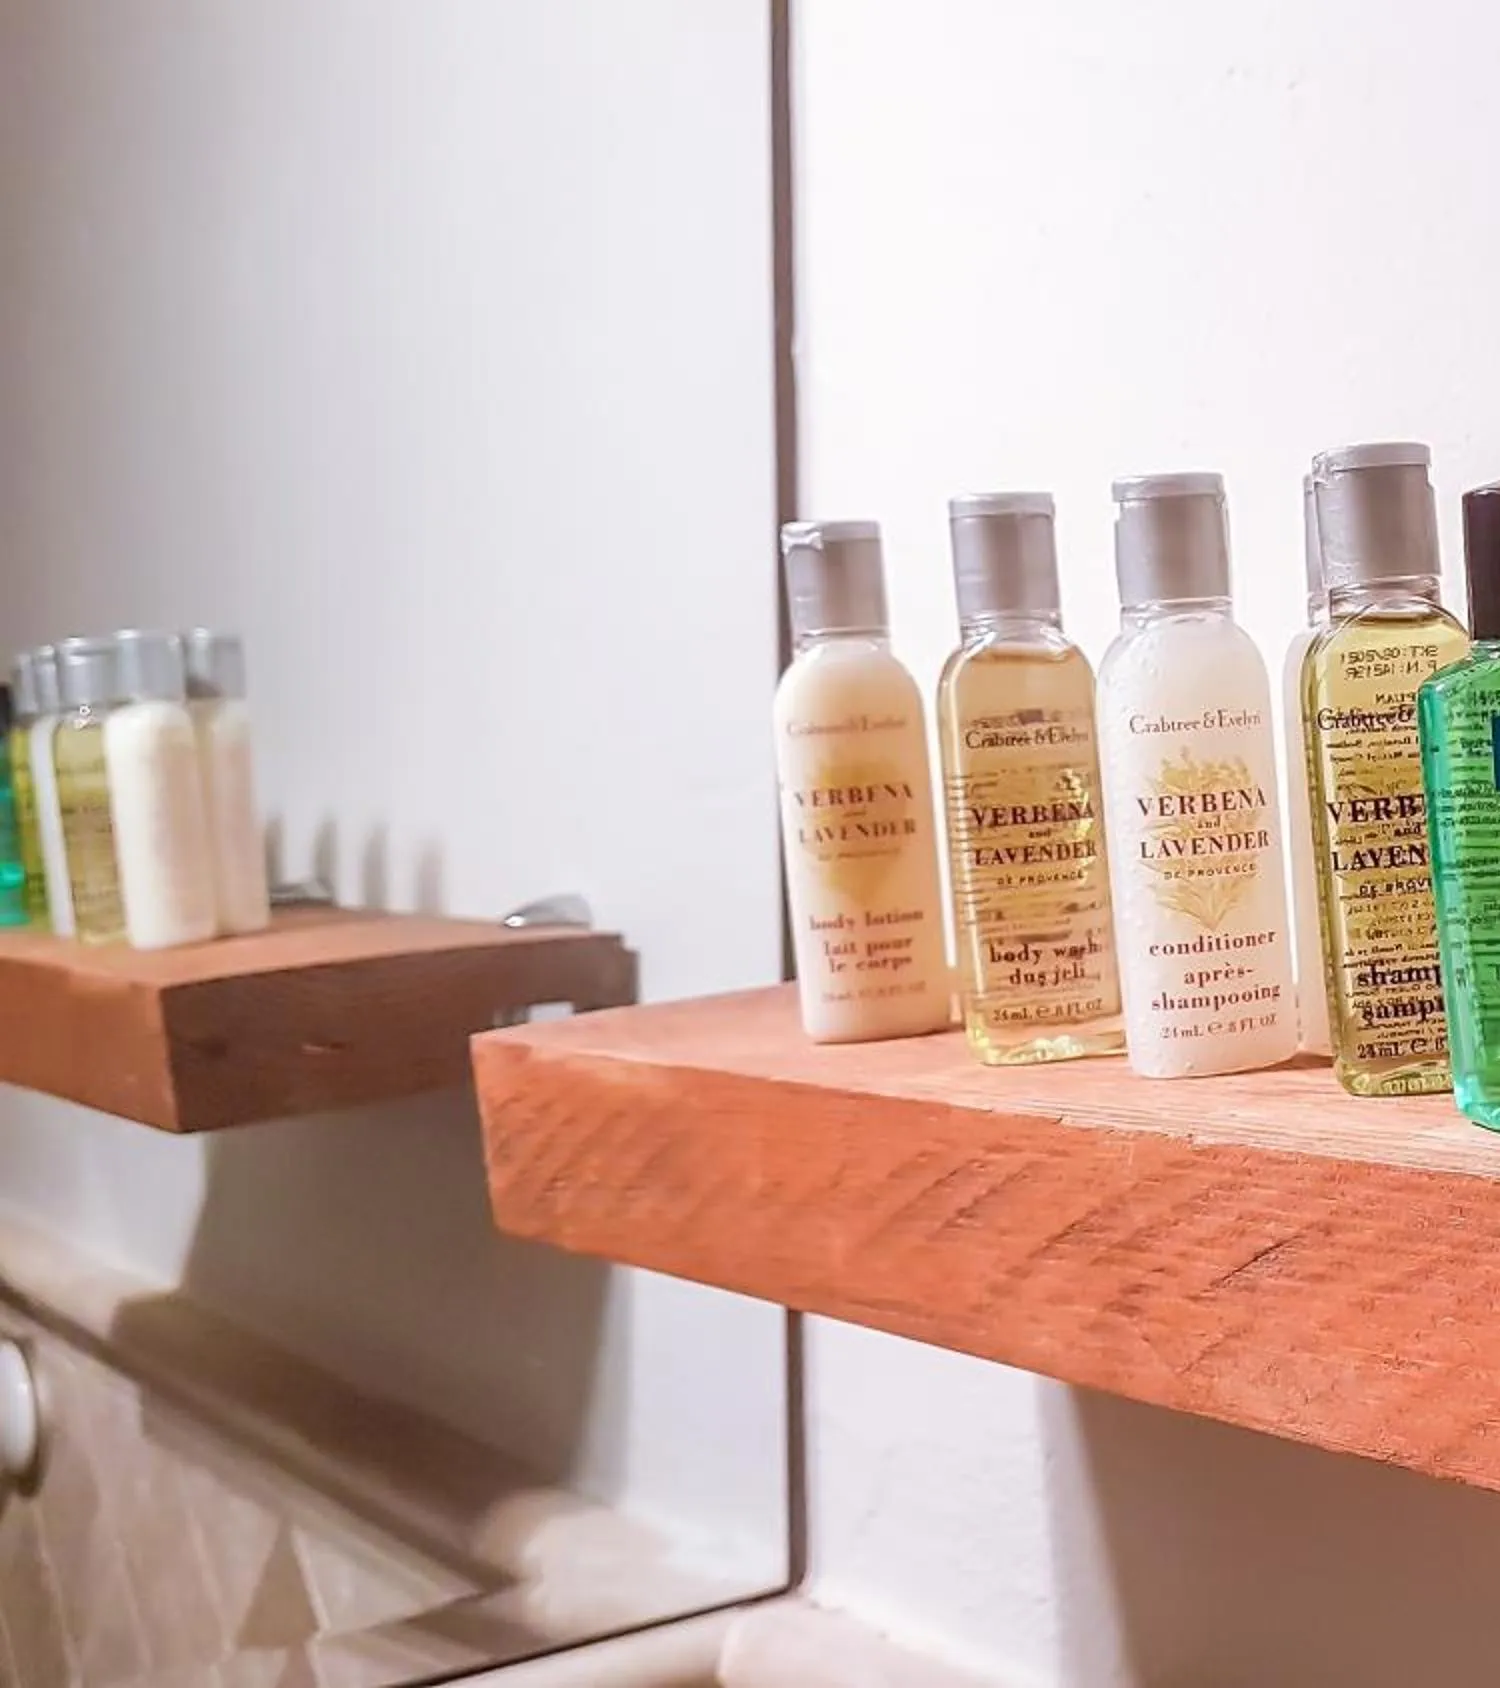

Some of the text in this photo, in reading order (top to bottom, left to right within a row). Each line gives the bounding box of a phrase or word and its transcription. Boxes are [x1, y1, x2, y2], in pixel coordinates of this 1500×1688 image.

[1129, 713, 1200, 735] Crabtree
[794, 783, 913, 807] VERBENA
[1136, 786, 1268, 817] VERBENA
[971, 801, 1095, 827] VERBENA
[1197, 814, 1222, 829] and
[1326, 794, 1426, 824] VERB
[799, 818, 917, 844] LAVENDER
[1028, 828, 1052, 838] and
[1140, 829, 1270, 859] LAVENDER
[974, 840, 1098, 866] LAVENDER
[1331, 844, 1429, 871] LAVEN
[1187, 863, 1258, 878] PROVENCE
[809, 912, 856, 932] body
[989, 942, 1042, 965] body
[1149, 931, 1276, 957] conditioner
[1184, 961, 1254, 988] après-
[1357, 964, 1442, 988] sham
[1151, 984, 1280, 1012] shampooing
